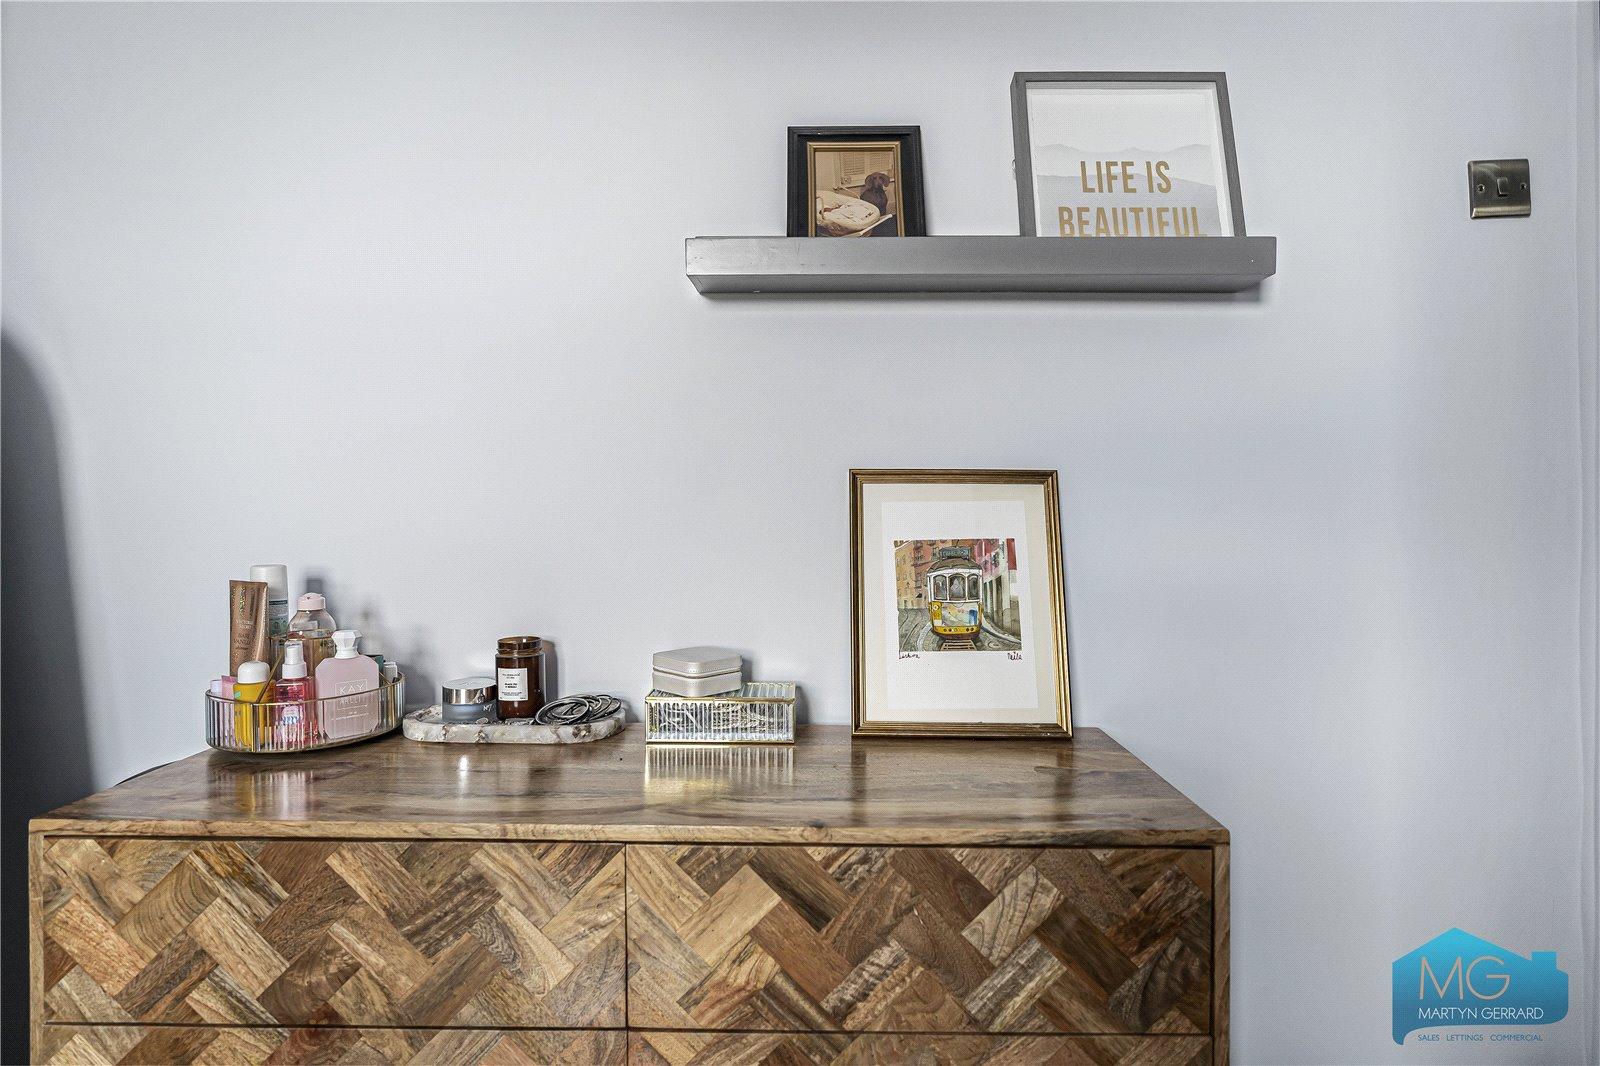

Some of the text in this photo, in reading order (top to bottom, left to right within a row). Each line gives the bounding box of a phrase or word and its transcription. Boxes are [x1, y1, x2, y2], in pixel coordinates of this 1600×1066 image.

[1080, 160, 1173, 194] LIFE IS
[1057, 206, 1208, 238] BEAUTIFUL
